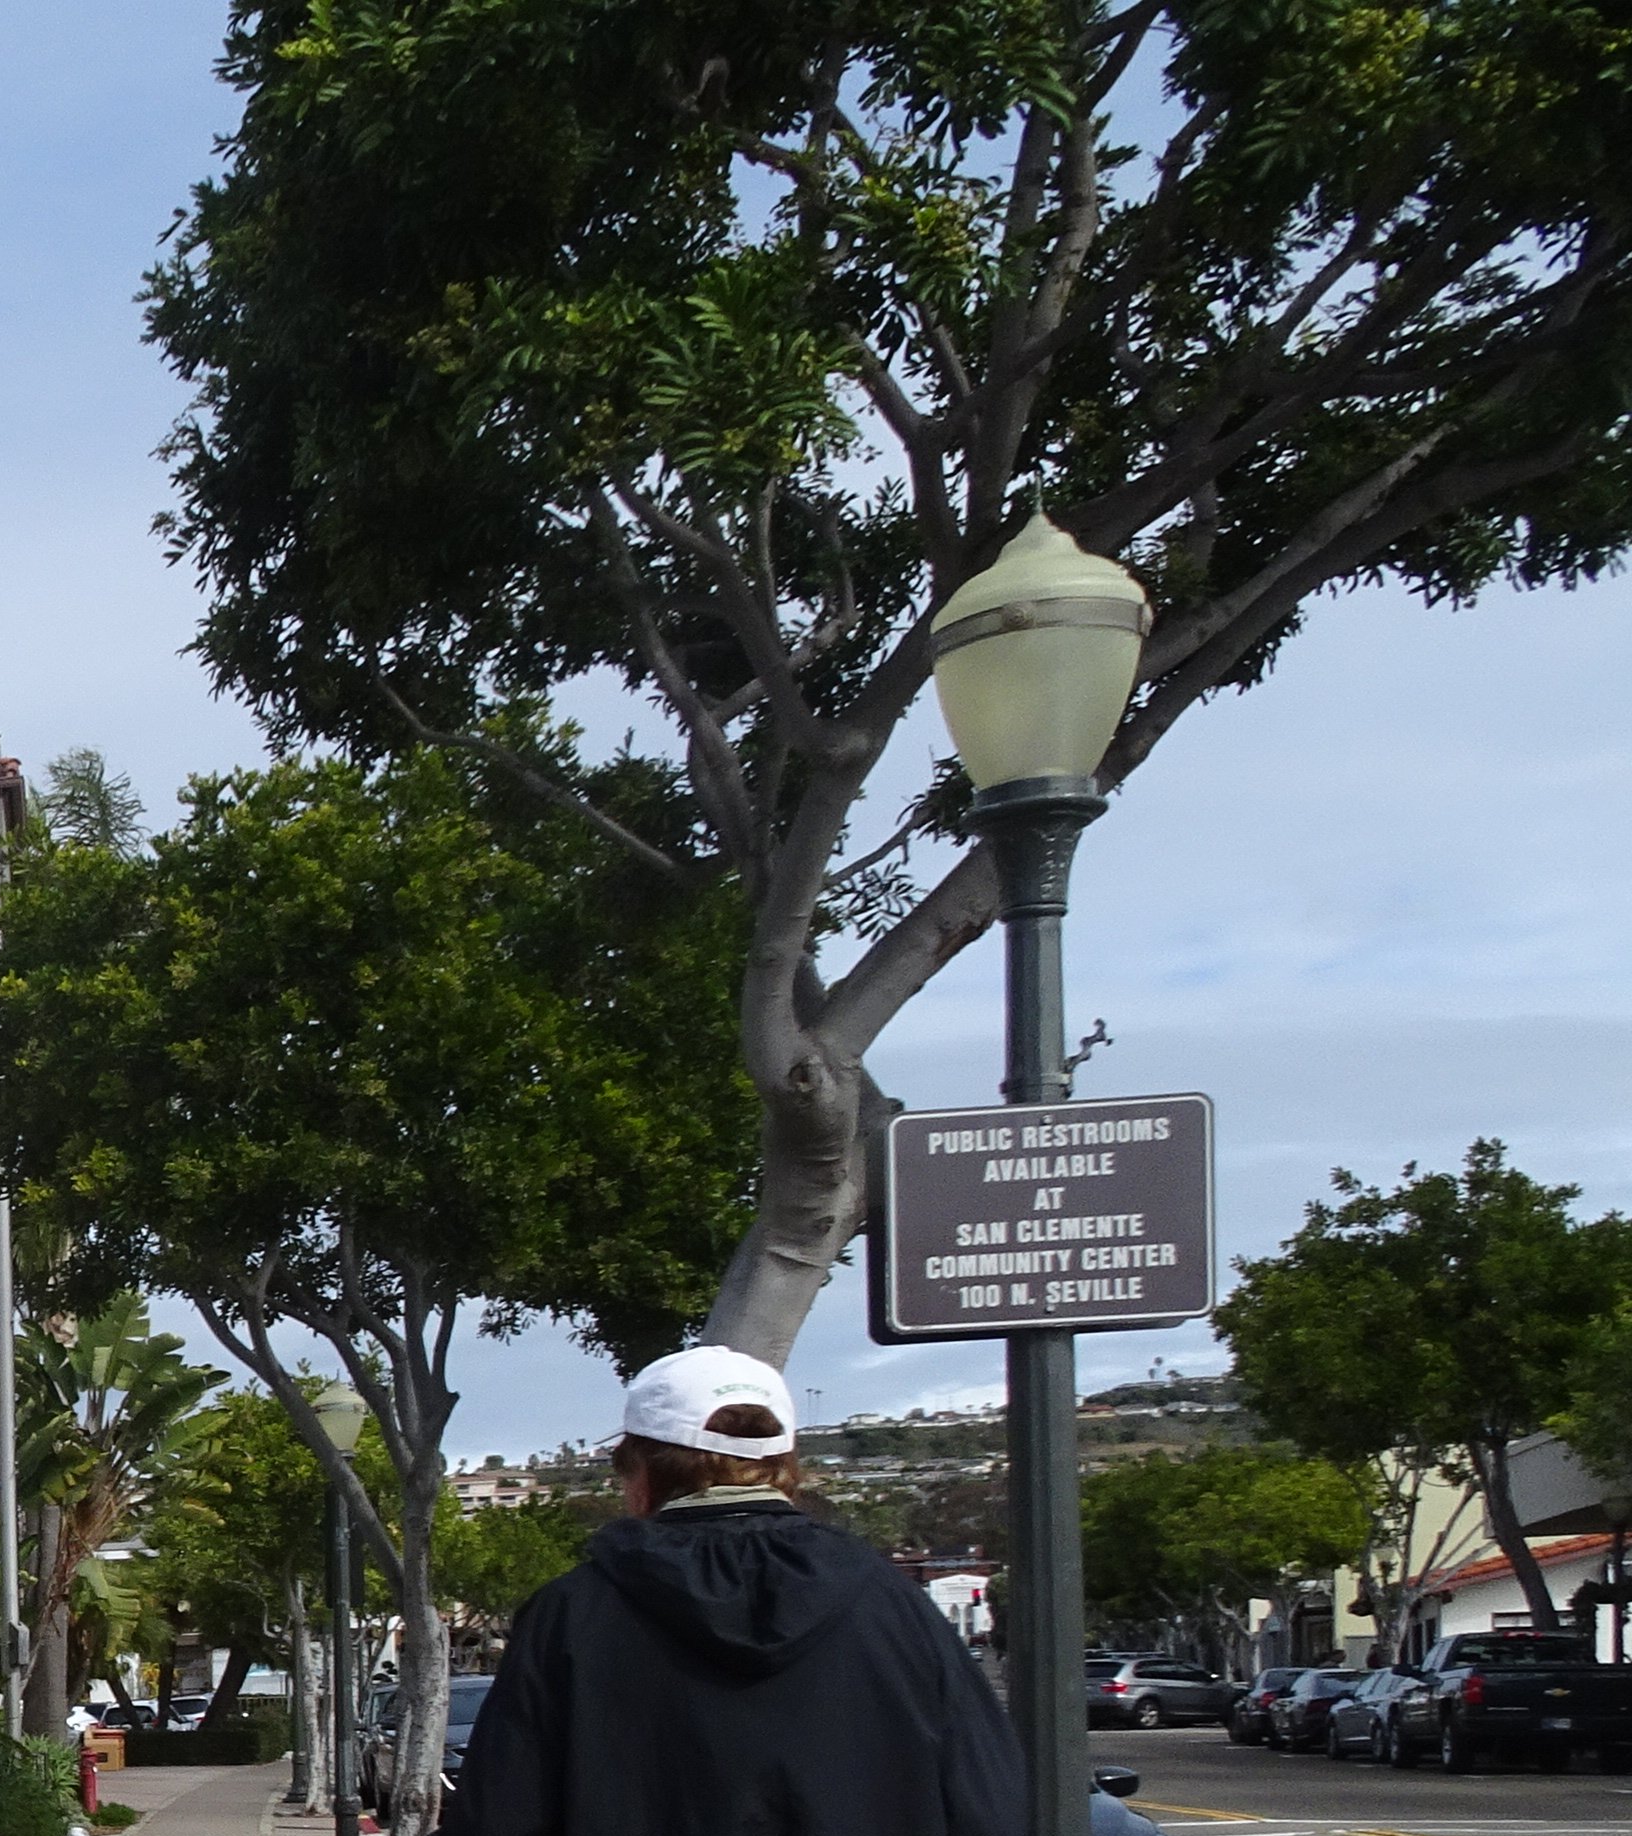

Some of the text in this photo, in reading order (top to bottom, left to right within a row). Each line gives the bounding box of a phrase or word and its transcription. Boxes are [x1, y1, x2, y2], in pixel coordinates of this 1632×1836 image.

[928, 1117, 1171, 1155] PUBLIC RESTROOMS
[983, 1152, 1116, 1183] AVAILABLE
[1034, 1187, 1065, 1211] AT
[956, 1213, 1145, 1246] SAN CLEMENTE
[926, 1243, 1177, 1280] COMMUNITY CENTER
[959, 1276, 1144, 1309] 100 N. SEVILLE
